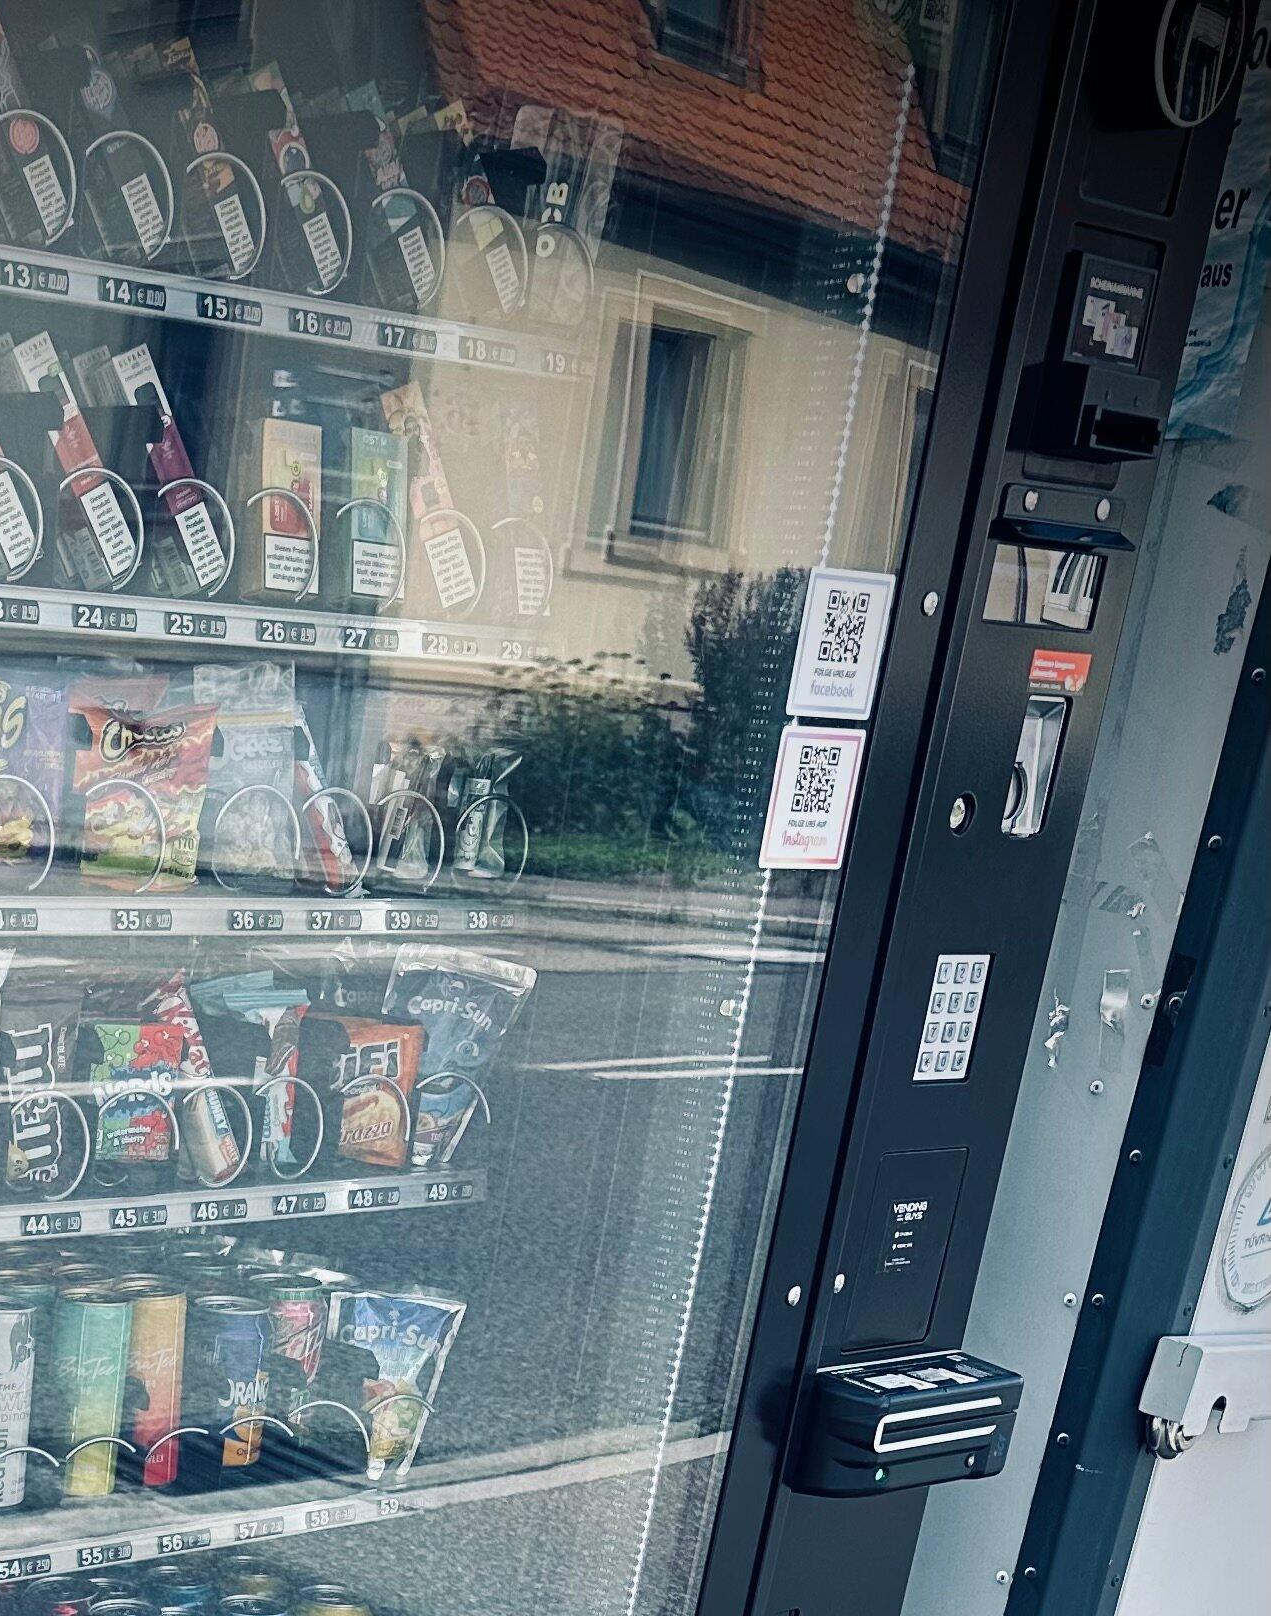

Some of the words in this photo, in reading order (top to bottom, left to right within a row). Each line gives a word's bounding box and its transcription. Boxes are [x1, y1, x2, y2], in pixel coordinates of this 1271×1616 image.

[4, 263, 30, 288] 13
[106, 279, 130, 303] 14
[204, 296, 227, 319] 15
[296, 311, 319, 333] 16
[384, 326, 405, 347] 17
[466, 339, 487, 360] 18
[546, 352, 566, 373] 19
[78, 607, 102, 627] 24
[170, 614, 194, 634] 25
[262, 622, 285, 642] 26
[345, 629, 367, 648] 27
[427, 635, 448, 655] 28
[502, 641, 522, 660] 29
[810, 679, 855, 697] facebook
[117, 910, 139, 930] 35
[233, 911, 254, 930] 36
[312, 911, 332, 930] 37
[390, 911, 411, 931] 39
[469, 911, 488, 929] 38
[408, 996, 492, 1032] Capri-Sun
[353, 1190, 373, 1206] 48
[429, 1183, 448, 1200] 49
[196, 1203, 218, 1220] 46
[276, 1196, 297, 1213] 47
[26, 1215, 49, 1234] 44
[114, 1209, 137, 1227] 45
[381, 1498, 399, 1515] 59
[311, 1510, 329, 1527] 58
[239, 1522, 258, 1539] 57
[162, 1534, 182, 1552] 56
[82, 1548, 103, 1566] 55
[0, 1561, 20, 1579] 54
